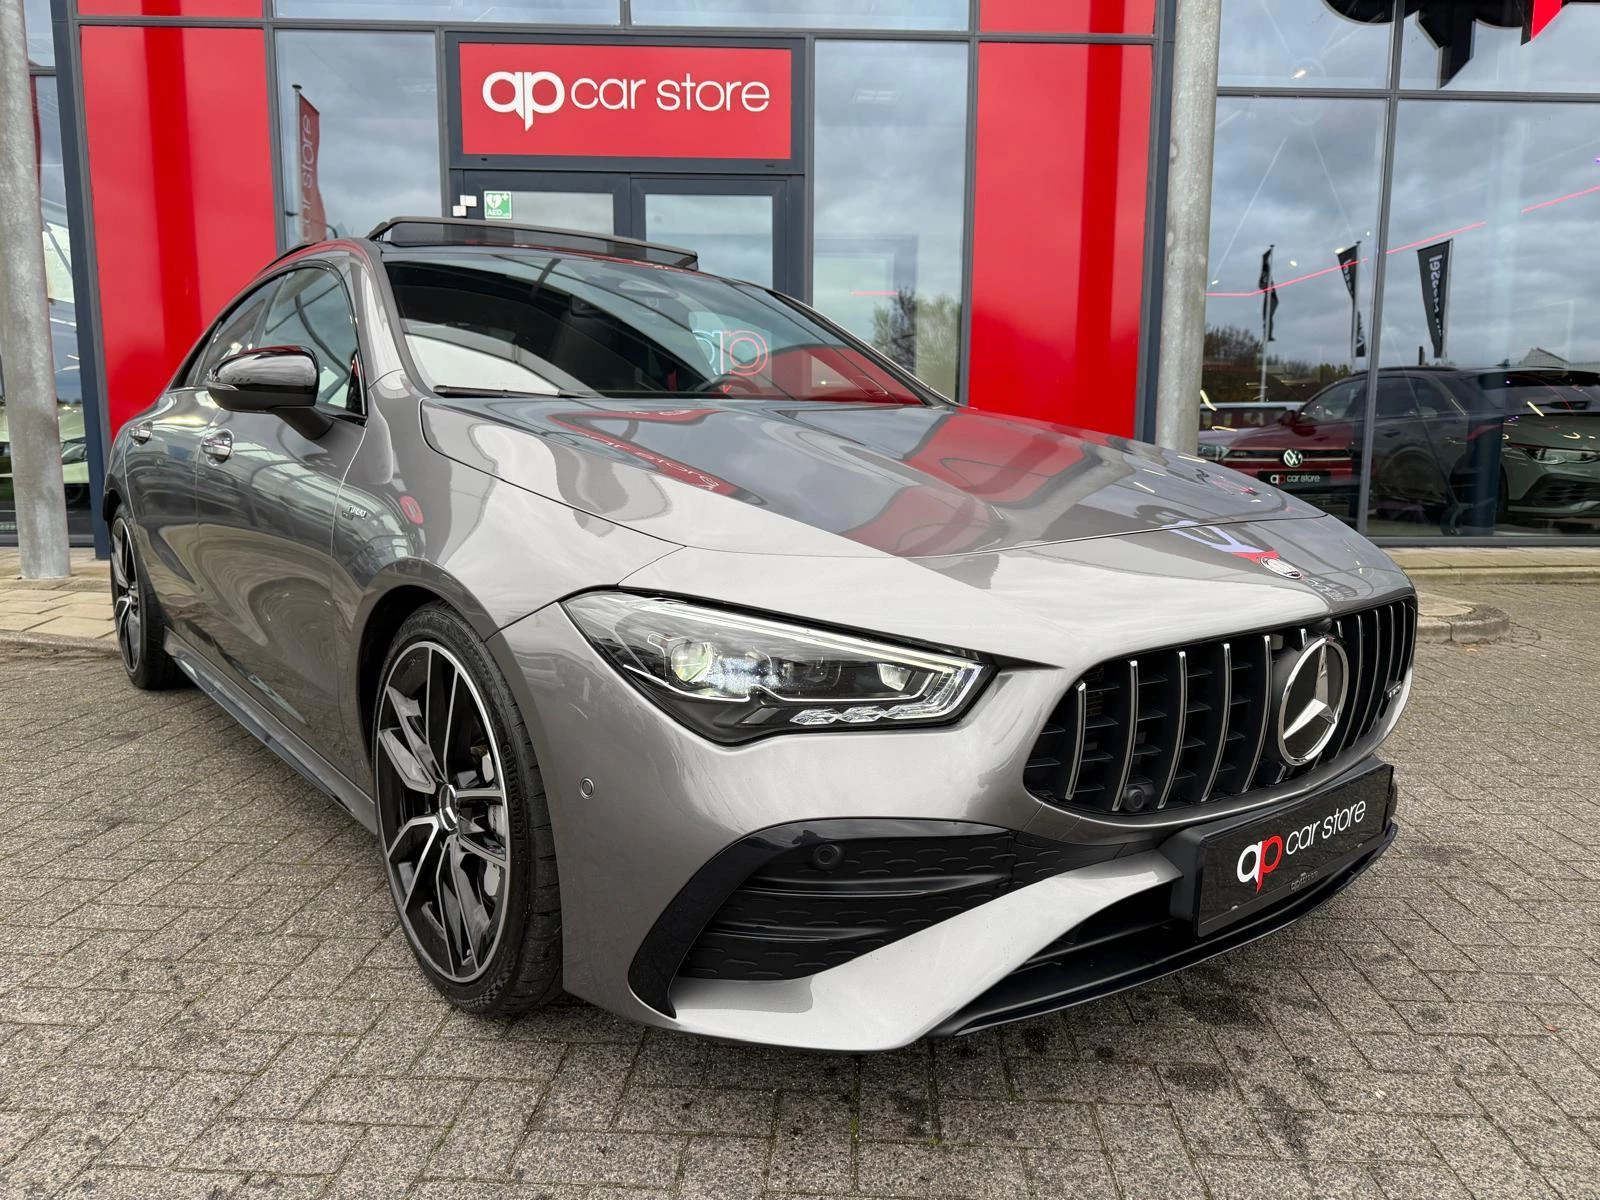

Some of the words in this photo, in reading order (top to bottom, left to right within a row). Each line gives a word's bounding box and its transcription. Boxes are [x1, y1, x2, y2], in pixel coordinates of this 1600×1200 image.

[482, 71, 565, 132] ap
[571, 77, 646, 111] car
[656, 73, 771, 112] store
[488, 208, 503, 216] AED
[1286, 475, 1300, 483] car
[1236, 835, 1283, 894] ap
[1286, 820, 1320, 855] car
[1322, 800, 1366, 839] store
